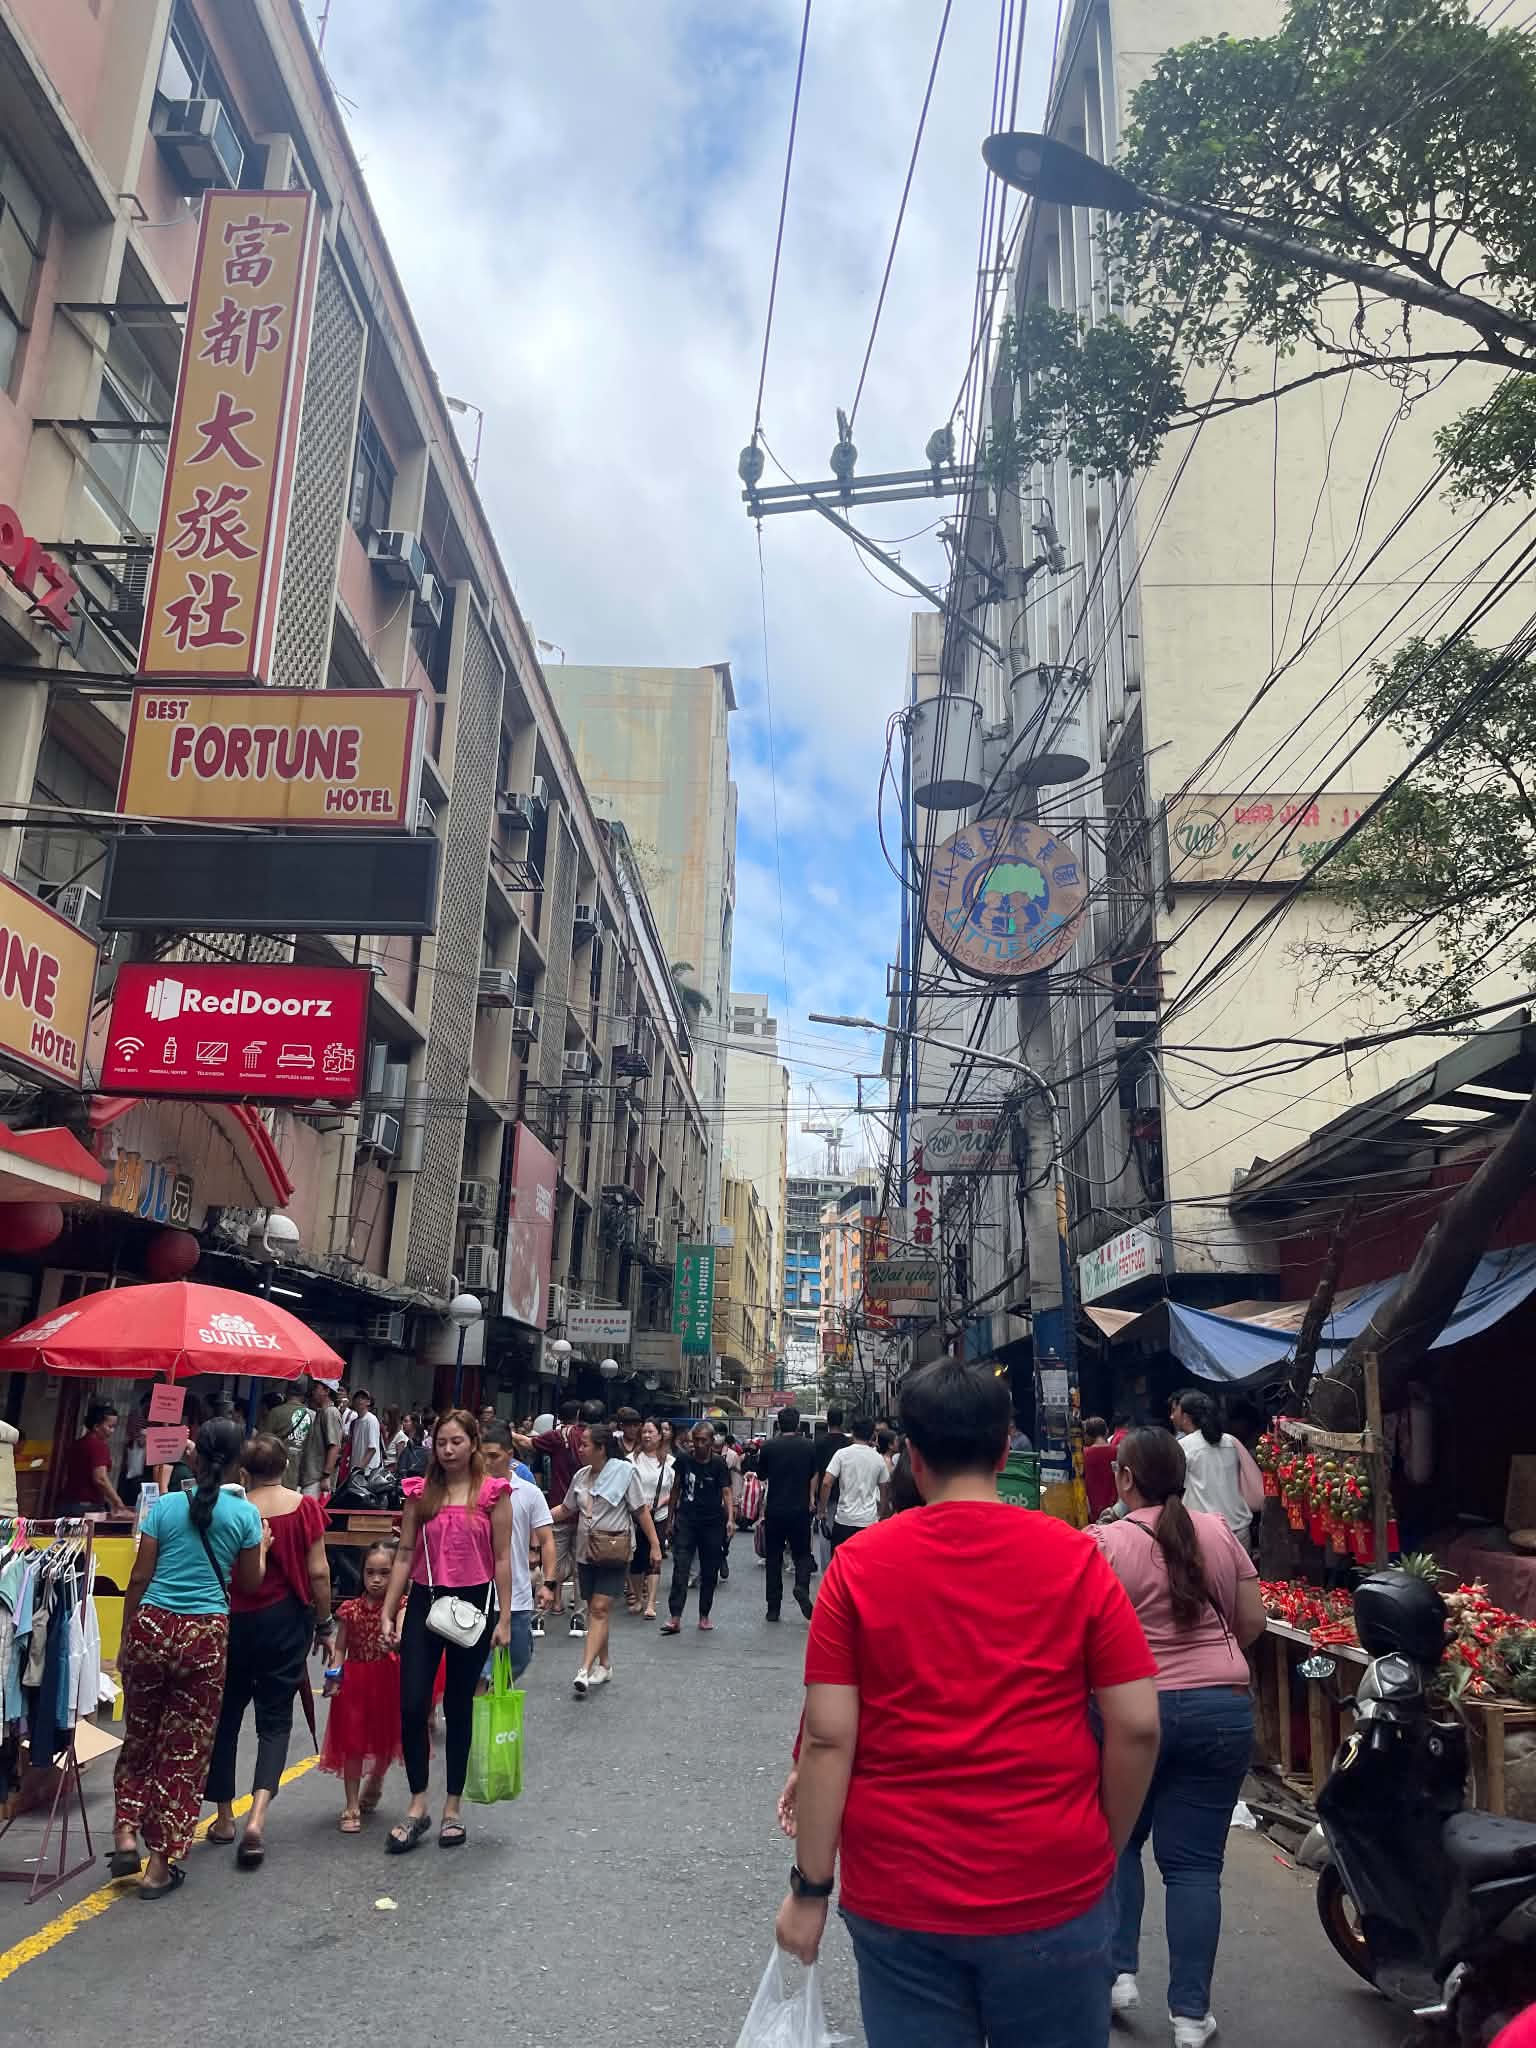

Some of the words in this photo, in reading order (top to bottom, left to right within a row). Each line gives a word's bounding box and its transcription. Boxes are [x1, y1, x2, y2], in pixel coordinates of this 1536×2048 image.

[163, 215, 291, 652] 富都大旅社
[145, 700, 189, 720] BEST
[170, 724, 361, 781] FORTUNE
[325, 788, 394, 813] HOTEL
[182, 988, 333, 1017] RedDoorz
[31, 1021, 78, 1072] HOTEL
[198, 1328, 281, 1350] SUNTEX
